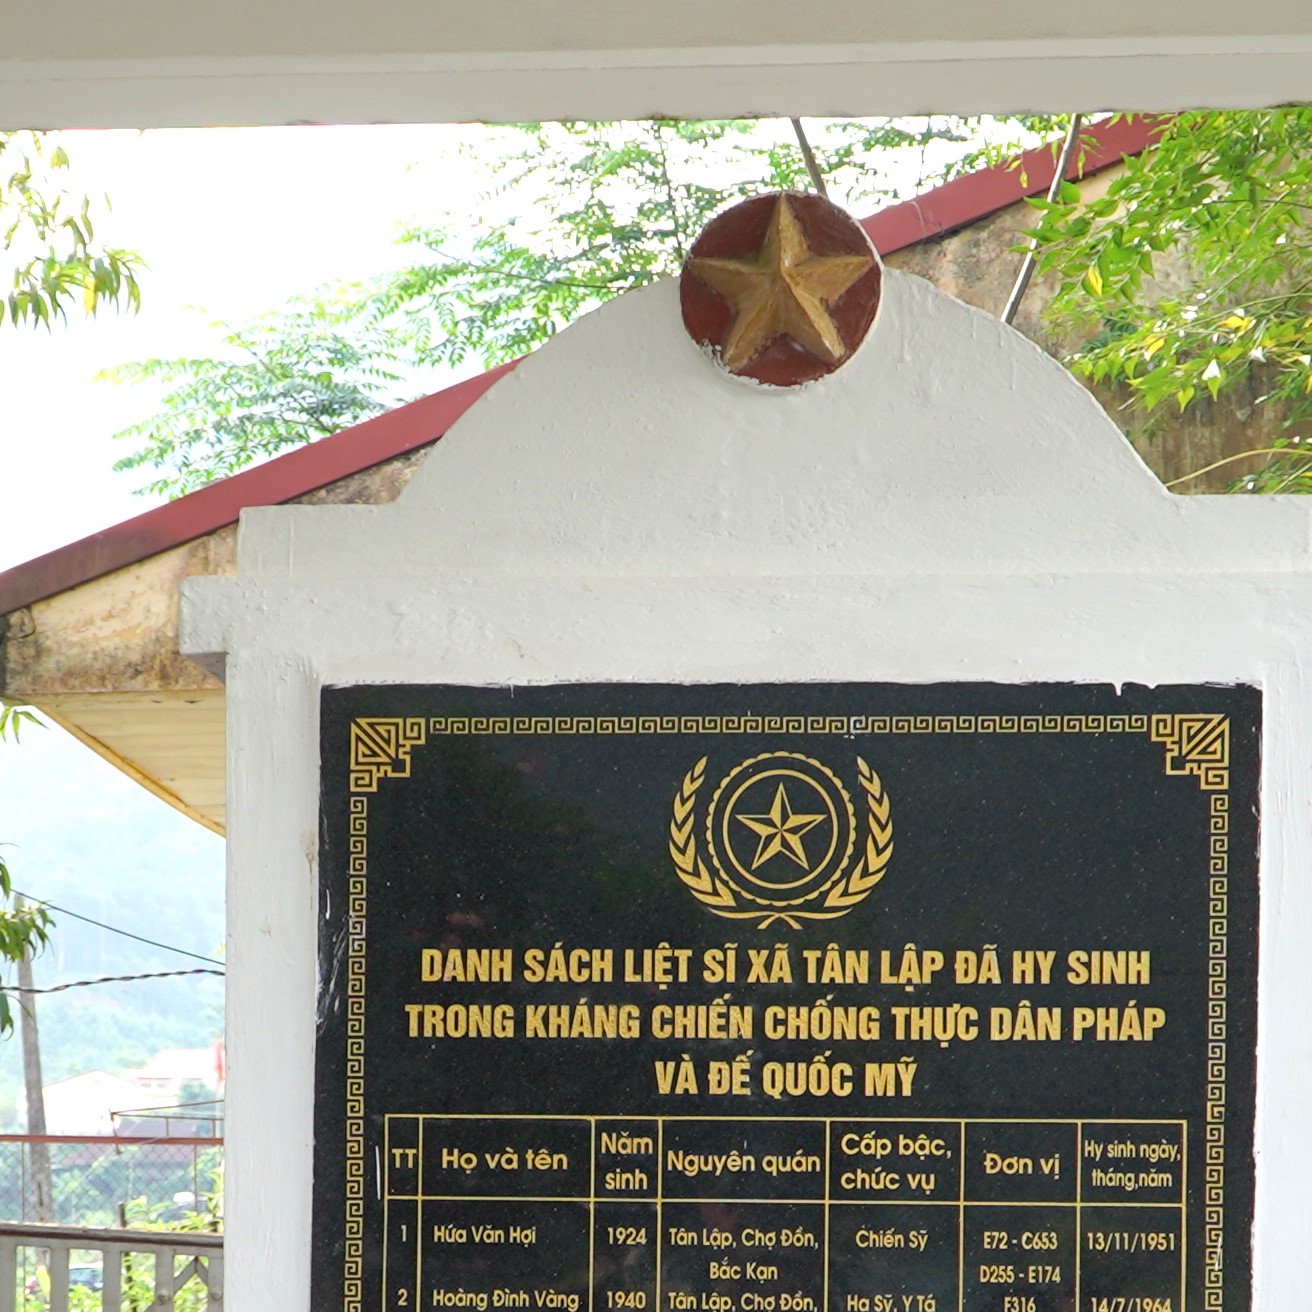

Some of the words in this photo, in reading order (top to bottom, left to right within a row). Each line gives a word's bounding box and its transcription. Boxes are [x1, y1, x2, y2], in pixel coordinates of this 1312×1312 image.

[421, 948, 513, 982] DANH
[523, 941, 614, 983] SÁCH
[624, 941, 693, 991] LIỆT
[702, 942, 739, 984] SĨ
[746, 942, 793, 984] XÃ
[802, 942, 870, 984] TÂN
[880, 942, 945, 993] LẬP
[953, 943, 1002, 985] ĐÃ
[1012, 950, 1057, 985] HY
[1066, 950, 1151, 985] SINH
[404, 1003, 515, 1039] TRONG
[525, 997, 641, 1039] KHÁNG
[651, 992, 753, 1040] CHIẾN
[764, 994, 881, 1041] CHỐNG
[890, 1003, 979, 1049] THỰC
[989, 999, 1062, 1041] DÂN
[1072, 999, 1166, 1042] PHÁP
[654, 1053, 699, 1095] VÀ
[707, 1049, 755, 1096] ĐẾ
[762, 1050, 854, 1100] QUỐC
[864, 1055, 918, 1097] MỸ
[601, 1131, 654, 1155] Năm
[840, 1130, 893, 1160] Cấp
[898, 1133, 952, 1161] bậc,
[1084, 1139, 1104, 1162] Hy
[1106, 1139, 1136, 1159] sinh
[1139, 1138, 1181, 1163] ngày,
[391, 1148, 418, 1169] TT
[441, 1147, 478, 1174] Họ
[484, 1146, 519, 1170] và
[525, 1148, 568, 1170] tên
[667, 1149, 756, 1177] Nguyên
[761, 1148, 821, 1177] quán
[983, 1152, 1033, 1175] Đơn
[1039, 1153, 1060, 1180] vị
[604, 1168, 648, 1190] sinh
[840, 1166, 900, 1190] chức
[906, 1173, 935, 1195] vụ
[400, 1224, 407, 1242] 1
[433, 1223, 467, 1243] Hứa
[471, 1224, 505, 1244] Văn
[509, 1226, 536, 1248] Hợi
[607, 1227, 648, 1245] 1924
[668, 1227, 698, 1246] Tân
[702, 1227, 737, 1250] Lập,
[741, 1228, 777, 1251] Chợ
[779, 1225, 819, 1250] Đồn,
[855, 1227, 905, 1248] Chiến
[908, 1229, 929, 1252] Sỹ
[983, 1231, 1008, 1250] E72
[1021, 1231, 1058, 1250] C653
[1087, 1231, 1175, 1253] 13/11/1951
[709, 1256, 742, 1280] Bắc
[746, 1261, 778, 1284] Kạn
[979, 1264, 1015, 1284] D255
[1028, 1265, 1062, 1284] E174
[397, 1288, 408, 1306] 2
[432, 1287, 488, 1312] Hoàng
[491, 1288, 530, 1308] Đình
[534, 1288, 580, 1312] Vàng
[606, 1290, 646, 1310] 1940
[667, 1291, 697, 1310] Tân
[901, 1294, 914, 1312] Y
[916, 1293, 936, 1312] Tá
